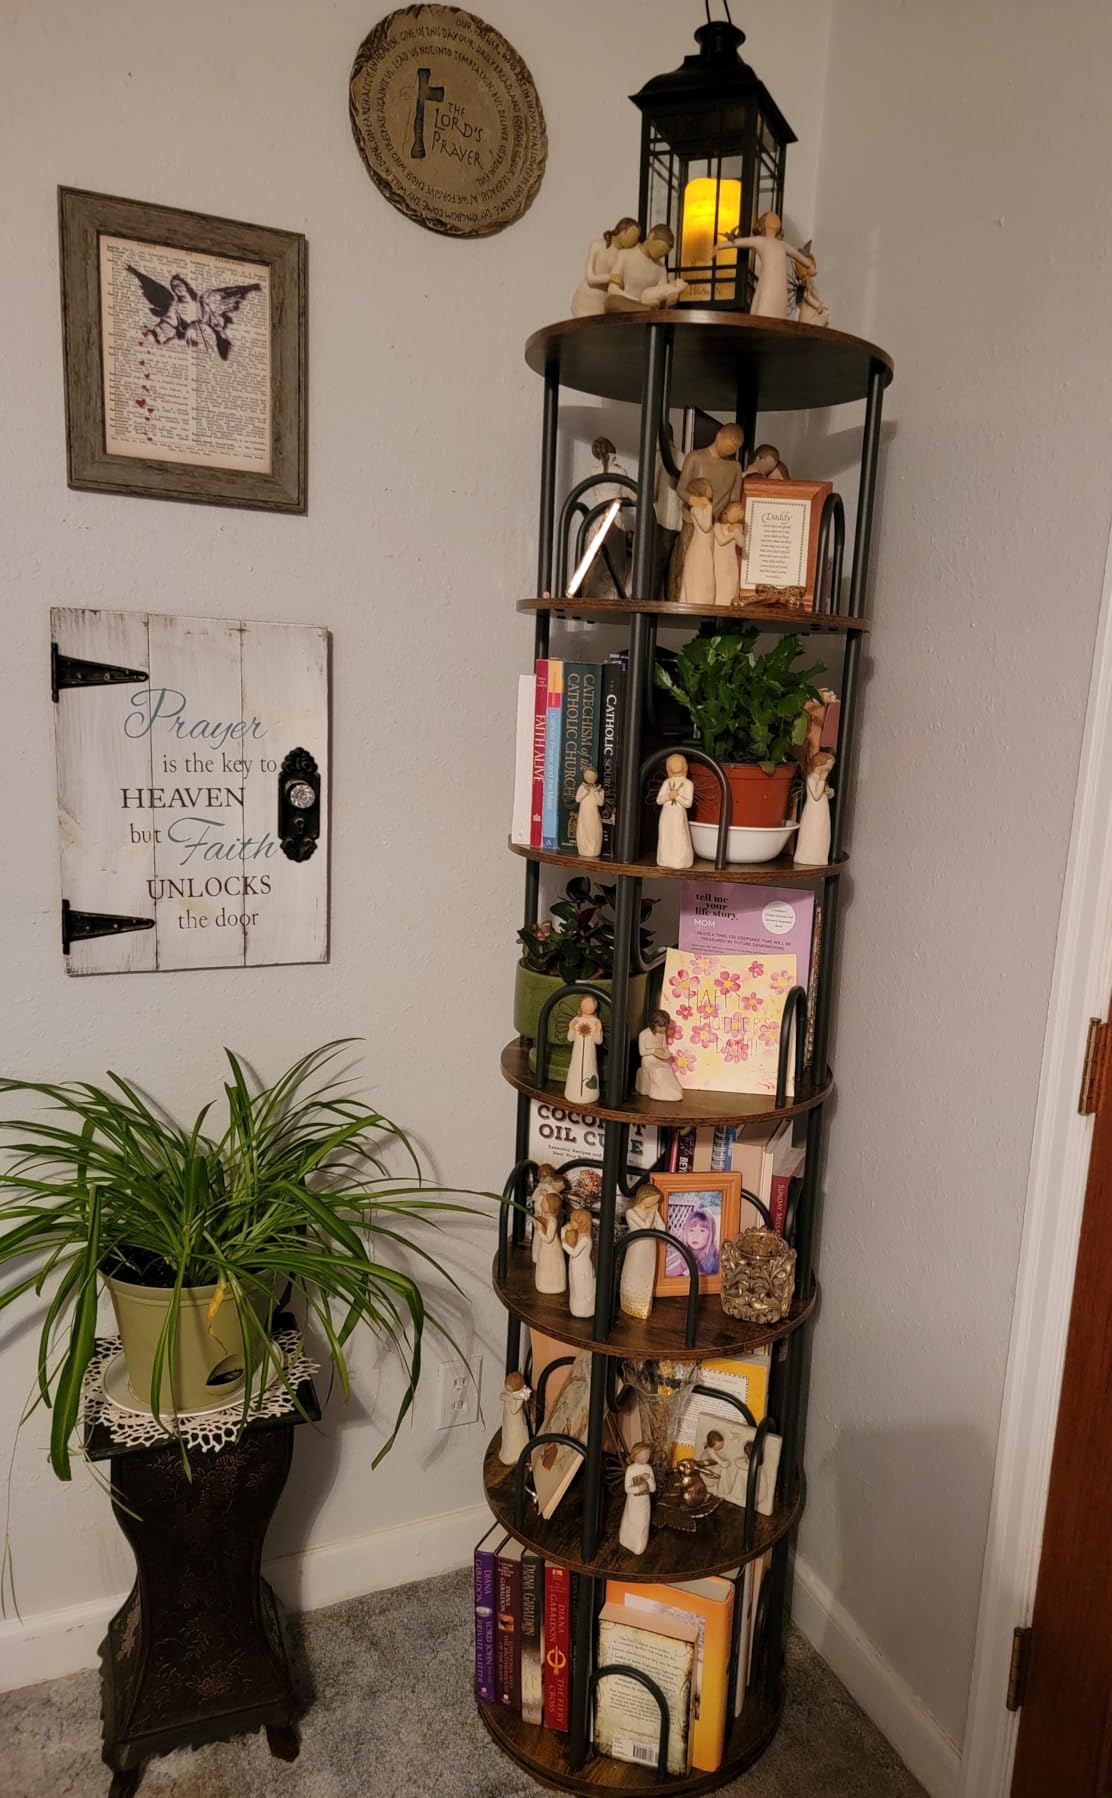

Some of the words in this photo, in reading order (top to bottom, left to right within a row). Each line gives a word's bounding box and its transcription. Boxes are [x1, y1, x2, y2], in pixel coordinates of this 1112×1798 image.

[448, 102, 465, 118] THE
[434, 107, 485, 144] LORD'S
[432, 131, 484, 171] PRAYER
[761, 511, 793, 525] Daddy
[124, 688, 268, 750] Prayer
[565, 673, 581, 740] CATHOLIC
[581, 674, 596, 747] CATECHISM
[534, 714, 547, 748] FAITH
[603, 693, 617, 756] CATHOLIC
[163, 755, 177, 773] is
[185, 752, 214, 773] the
[222, 752, 253, 780] key
[260, 757, 277, 773] to
[533, 750, 545, 782] ALIVE
[577, 747, 592, 760] of
[564, 741, 578, 801] CHURCH
[120, 787, 246, 809] HEAVEN
[130, 823, 162, 845] but
[167, 817, 279, 866] Faith
[146, 875, 272, 900] UNLOCKS
[695, 893, 711, 902] tell
[714, 896, 729, 904] me
[178, 909, 208, 930] the
[216, 907, 259, 928] door
[695, 906, 711, 917] life
[706, 903, 728, 911] your
[693, 918, 716, 928] MOM
[687, 986, 745, 1010] HAPPY
[699, 1014, 771, 1036] MOTHER'S
[537, 1104, 647, 1138] COCOT
[539, 1123, 577, 1144] OIL
[583, 1130, 645, 1155] CUE
[776, 1183, 785, 1212] SUNDAY
[775, 1212, 783, 1234] MISSA
[475, 1559, 483, 1603] GABALDON
[483, 1569, 492, 1595] DIANA
[522, 1563, 535, 1590] DIANA
[522, 1592, 535, 1638] GABALDON
[485, 1621, 493, 1643] LORD
[485, 1643, 493, 1665] JOHN
[548, 1684, 556, 1713] CROSS
[557, 1679, 565, 1698] THE
[557, 1698, 565, 1724] FIERY
